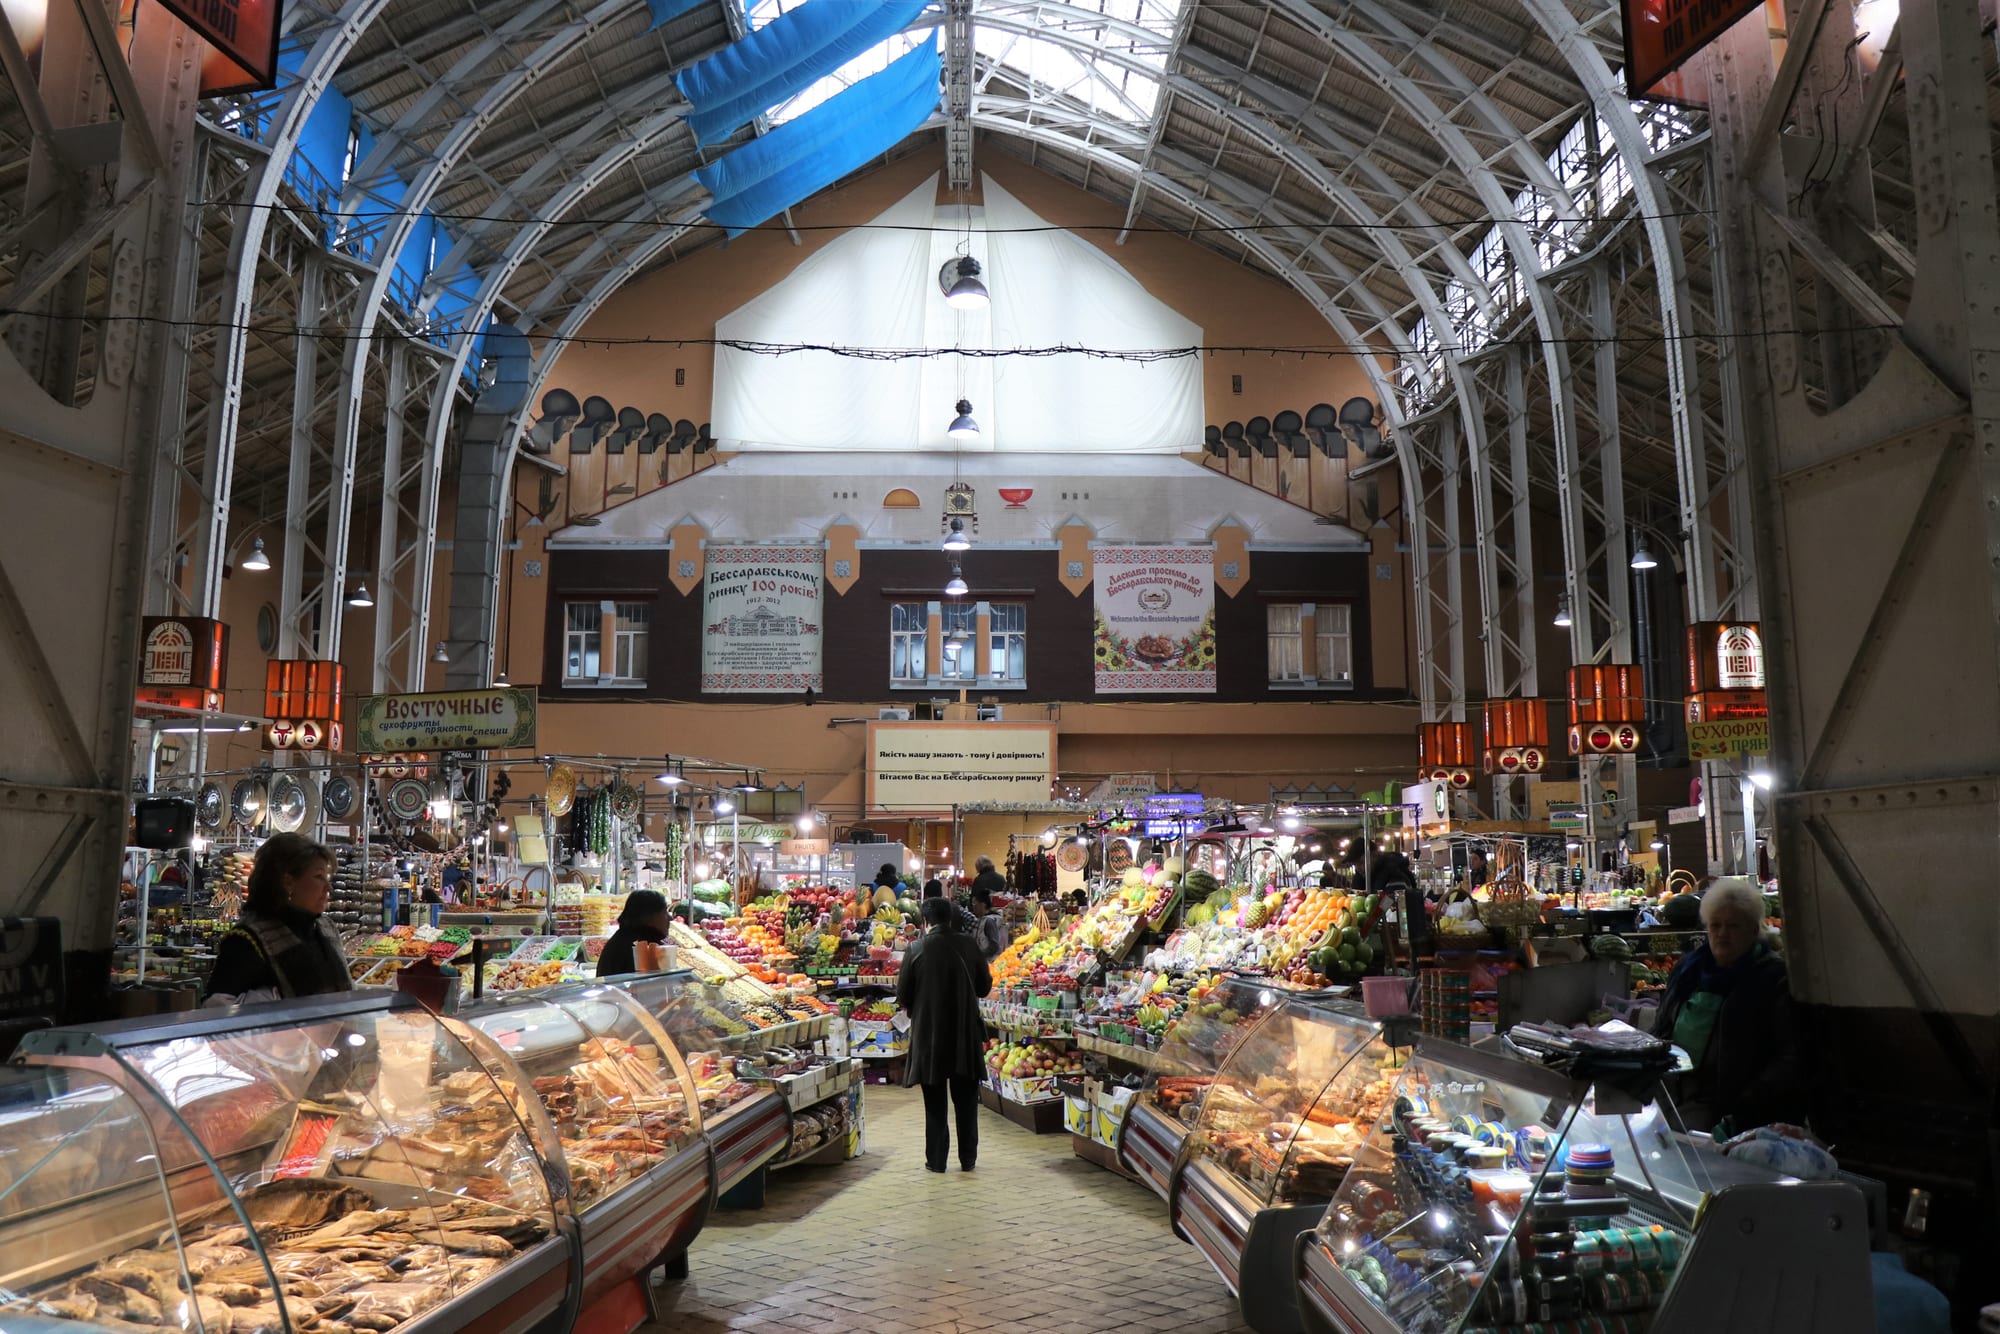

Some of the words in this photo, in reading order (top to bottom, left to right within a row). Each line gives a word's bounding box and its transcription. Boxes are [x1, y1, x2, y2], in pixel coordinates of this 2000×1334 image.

[711, 567, 819, 588] Бессарабському
[1109, 568, 1146, 585] Ласкаво
[1149, 568, 1187, 579] просимо
[1188, 576, 1200, 586] до
[708, 584, 748, 603] ринку
[752, 580, 776, 592] 100
[780, 584, 819, 600] років!
[1106, 577, 1172, 597] Бессарабського
[1174, 579, 1204, 598] ринку!
[746, 596, 760, 605] 1912
[766, 596, 780, 605] 2012
[379, 720, 440, 730] сухофрукты
[425, 724, 473, 734] пряности
[473, 727, 508, 736] специи
[908, 752, 930, 760] нашу
[970, 752, 990, 760] тому
[996, 751, 1044, 760] довіряють!
[943, 773, 1014, 782] Бессарабському
[1016, 774, 1044, 782] ринку!
